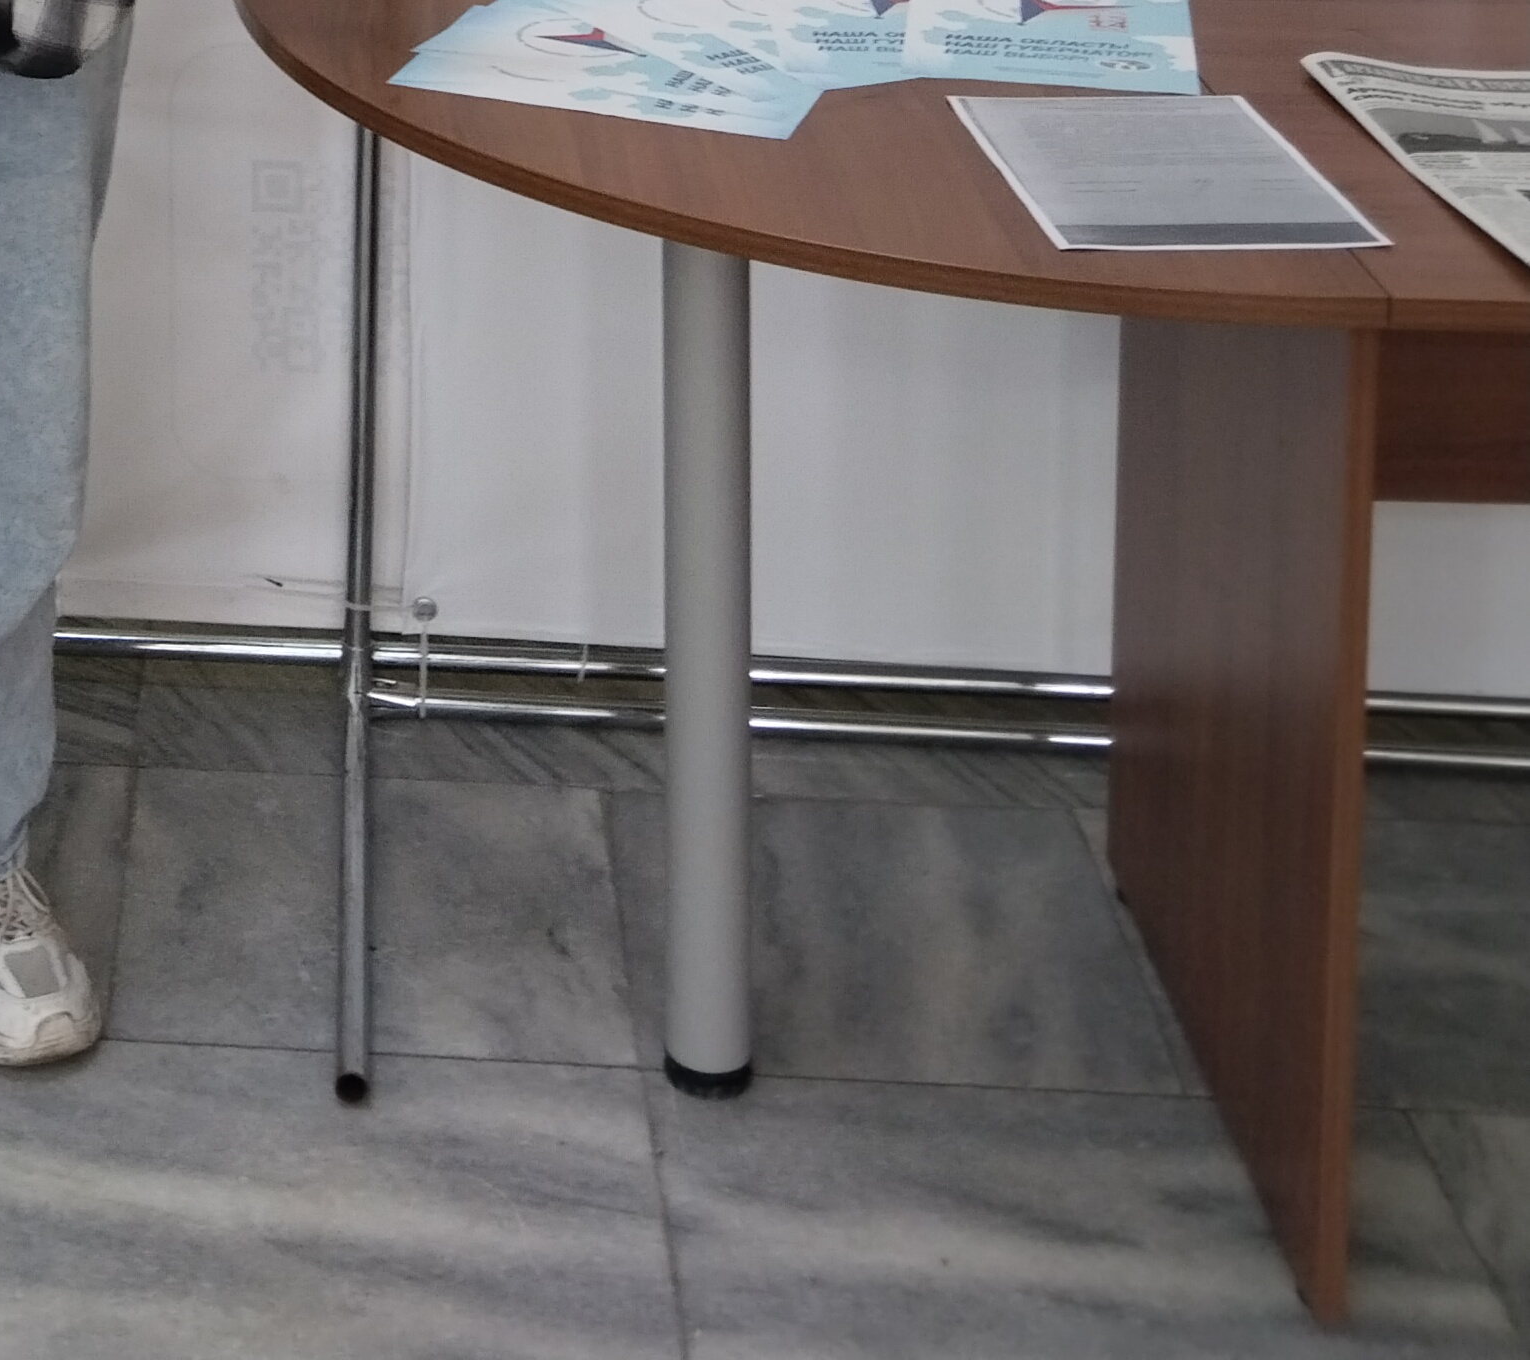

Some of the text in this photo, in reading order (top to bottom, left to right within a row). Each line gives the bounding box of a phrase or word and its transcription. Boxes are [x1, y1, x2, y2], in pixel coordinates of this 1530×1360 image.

[945, 34, 1012, 44] НАША
[818, 45, 870, 53] НАШ
[945, 41, 1000, 50] НАШ
[945, 48, 999, 57] НАШ
